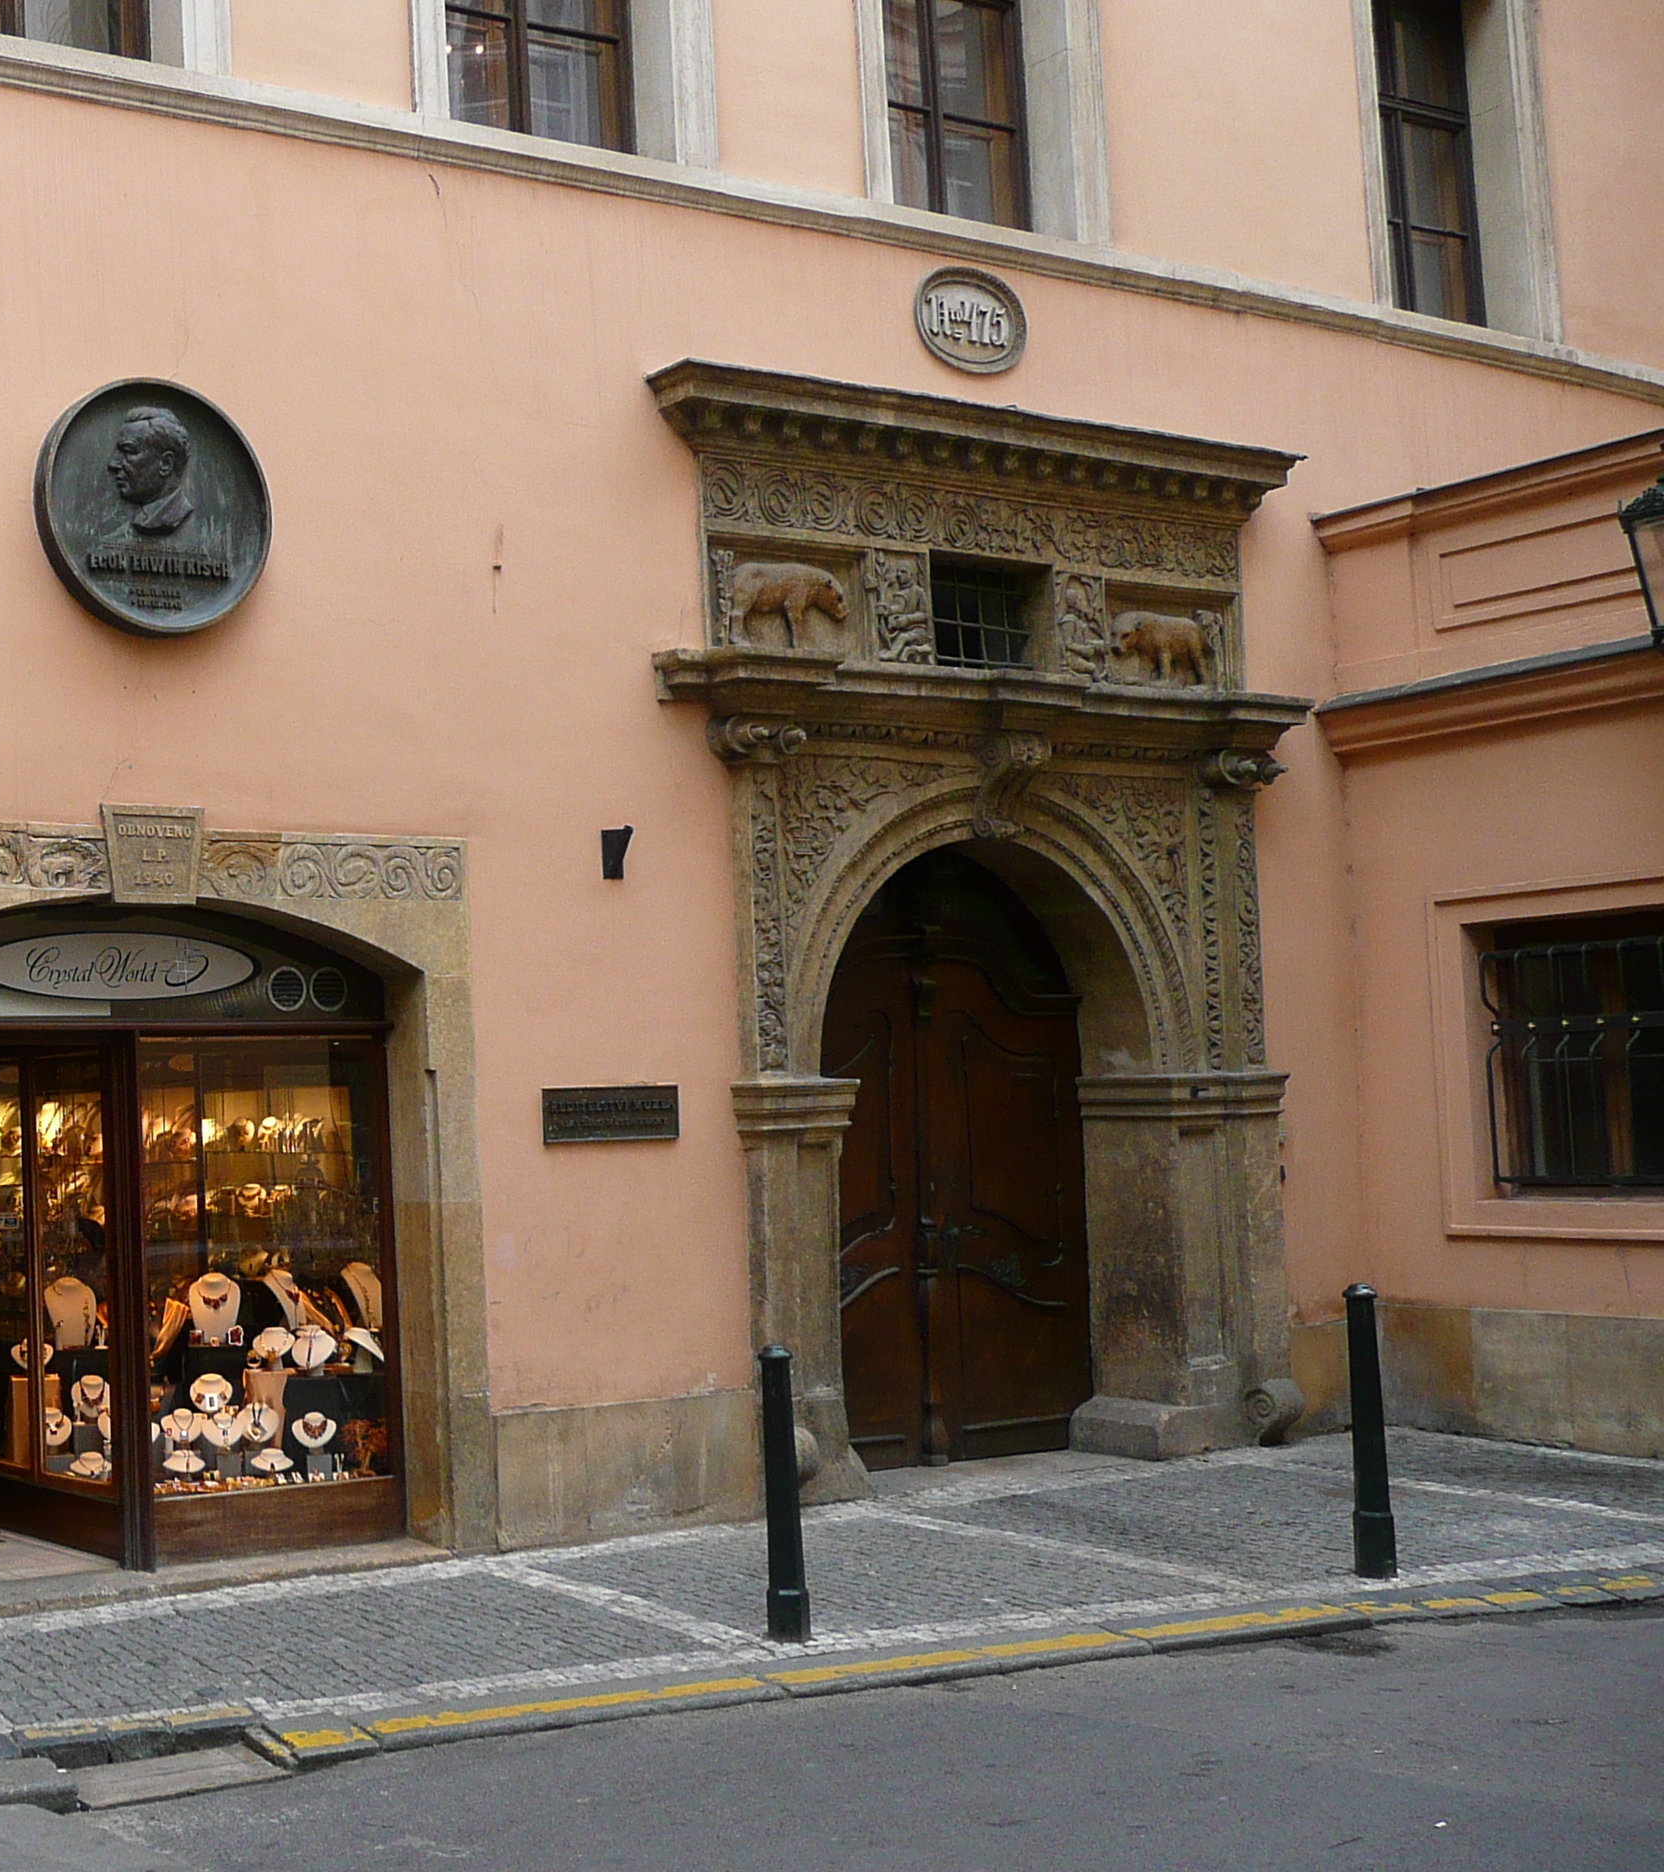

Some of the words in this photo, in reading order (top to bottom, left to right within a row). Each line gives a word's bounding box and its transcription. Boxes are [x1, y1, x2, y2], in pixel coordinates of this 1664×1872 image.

[132, 555, 184, 574] ERWIN
[186, 559, 231, 577] KISCH
[118, 823, 193, 839] OBNOVENO
[26, 946, 94, 989] Crystal
[94, 946, 159, 988] World
